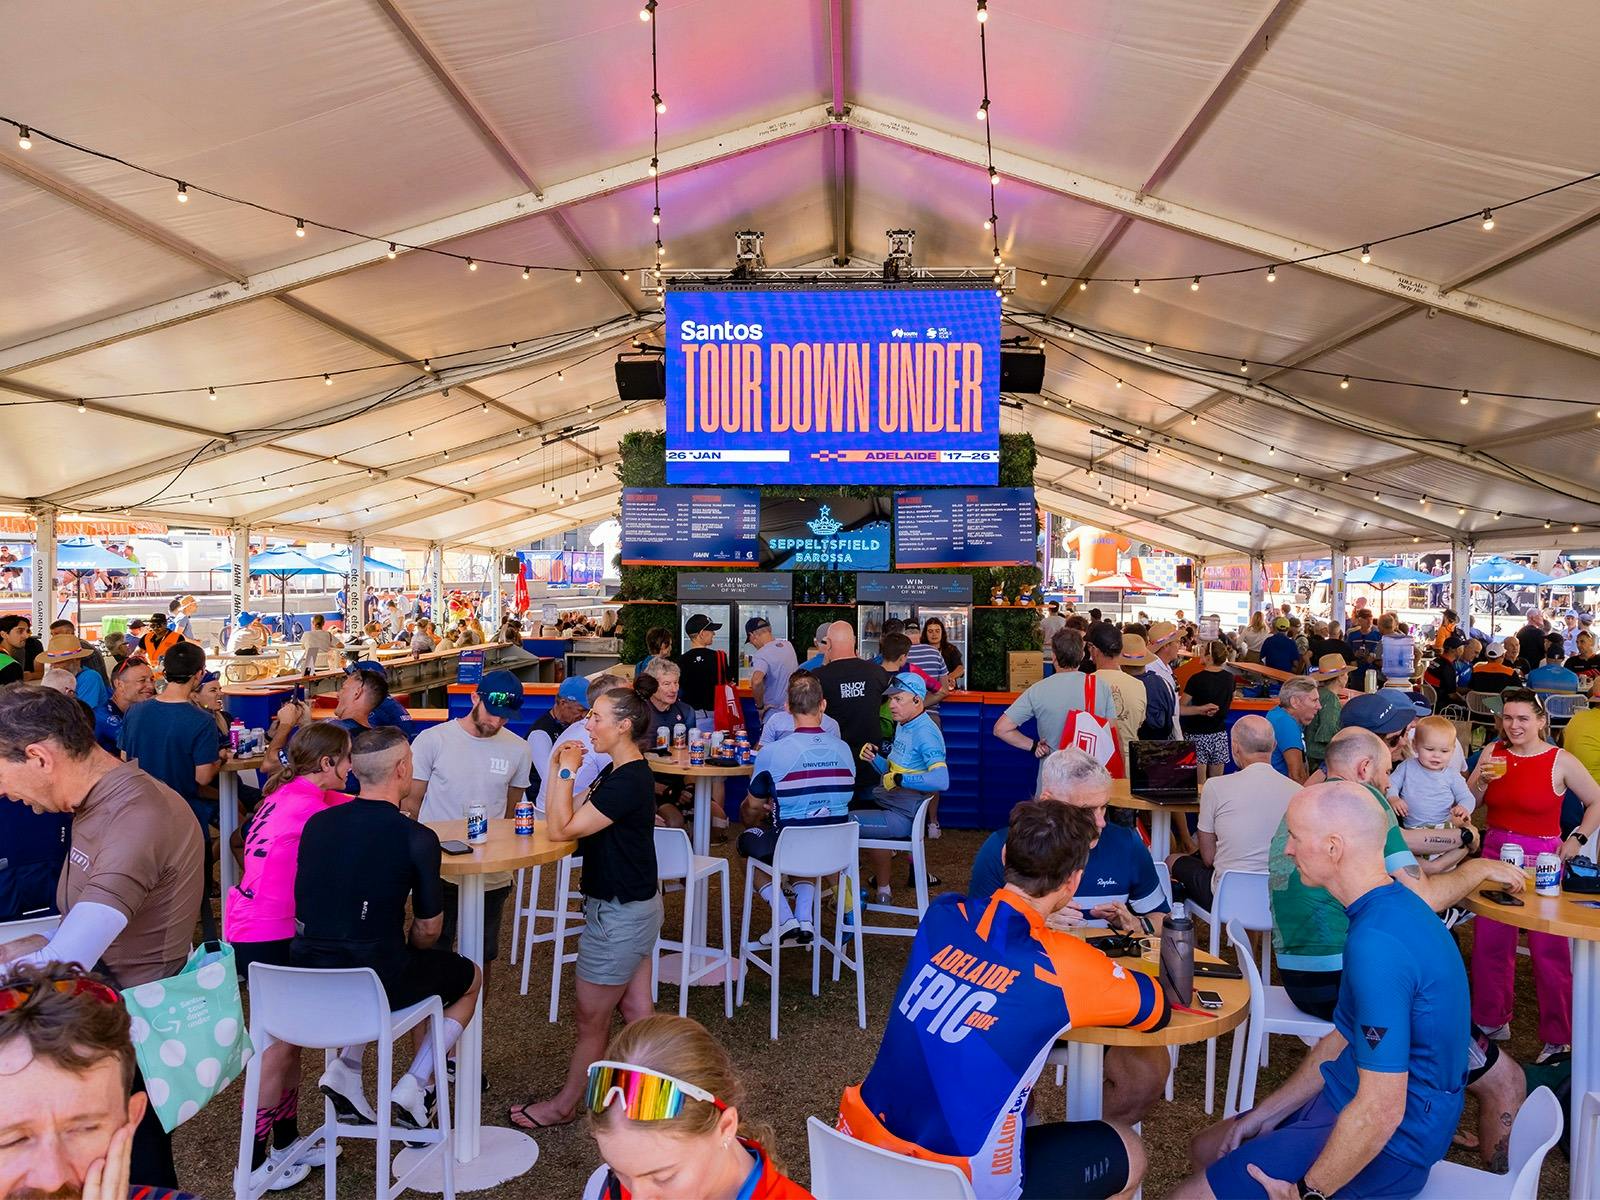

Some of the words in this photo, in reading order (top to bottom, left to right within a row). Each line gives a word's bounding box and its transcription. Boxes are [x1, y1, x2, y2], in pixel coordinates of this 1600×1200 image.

[680, 319, 764, 341] Santos
[681, 342, 763, 433] TOUR
[770, 342, 870, 433] DOWN
[878, 342, 983, 433] UNDER
[865, 452, 937, 460] ADELAIDE
[769, 539, 880, 551] SEPPELTSFIELD
[795, 553, 853, 563] BAROSSA
[840, 681, 866, 691] ENJOY
[846, 688, 865, 698] RIDE
[1096, 877, 1118, 888] Rapha
[930, 944, 1021, 994] ADELAIDE
[898, 963, 998, 1043] EPIC
[963, 1010, 999, 1031] RIDE
[991, 1114, 1017, 1176] ADELAIDE
[1084, 1156, 1110, 1183] MAAP
